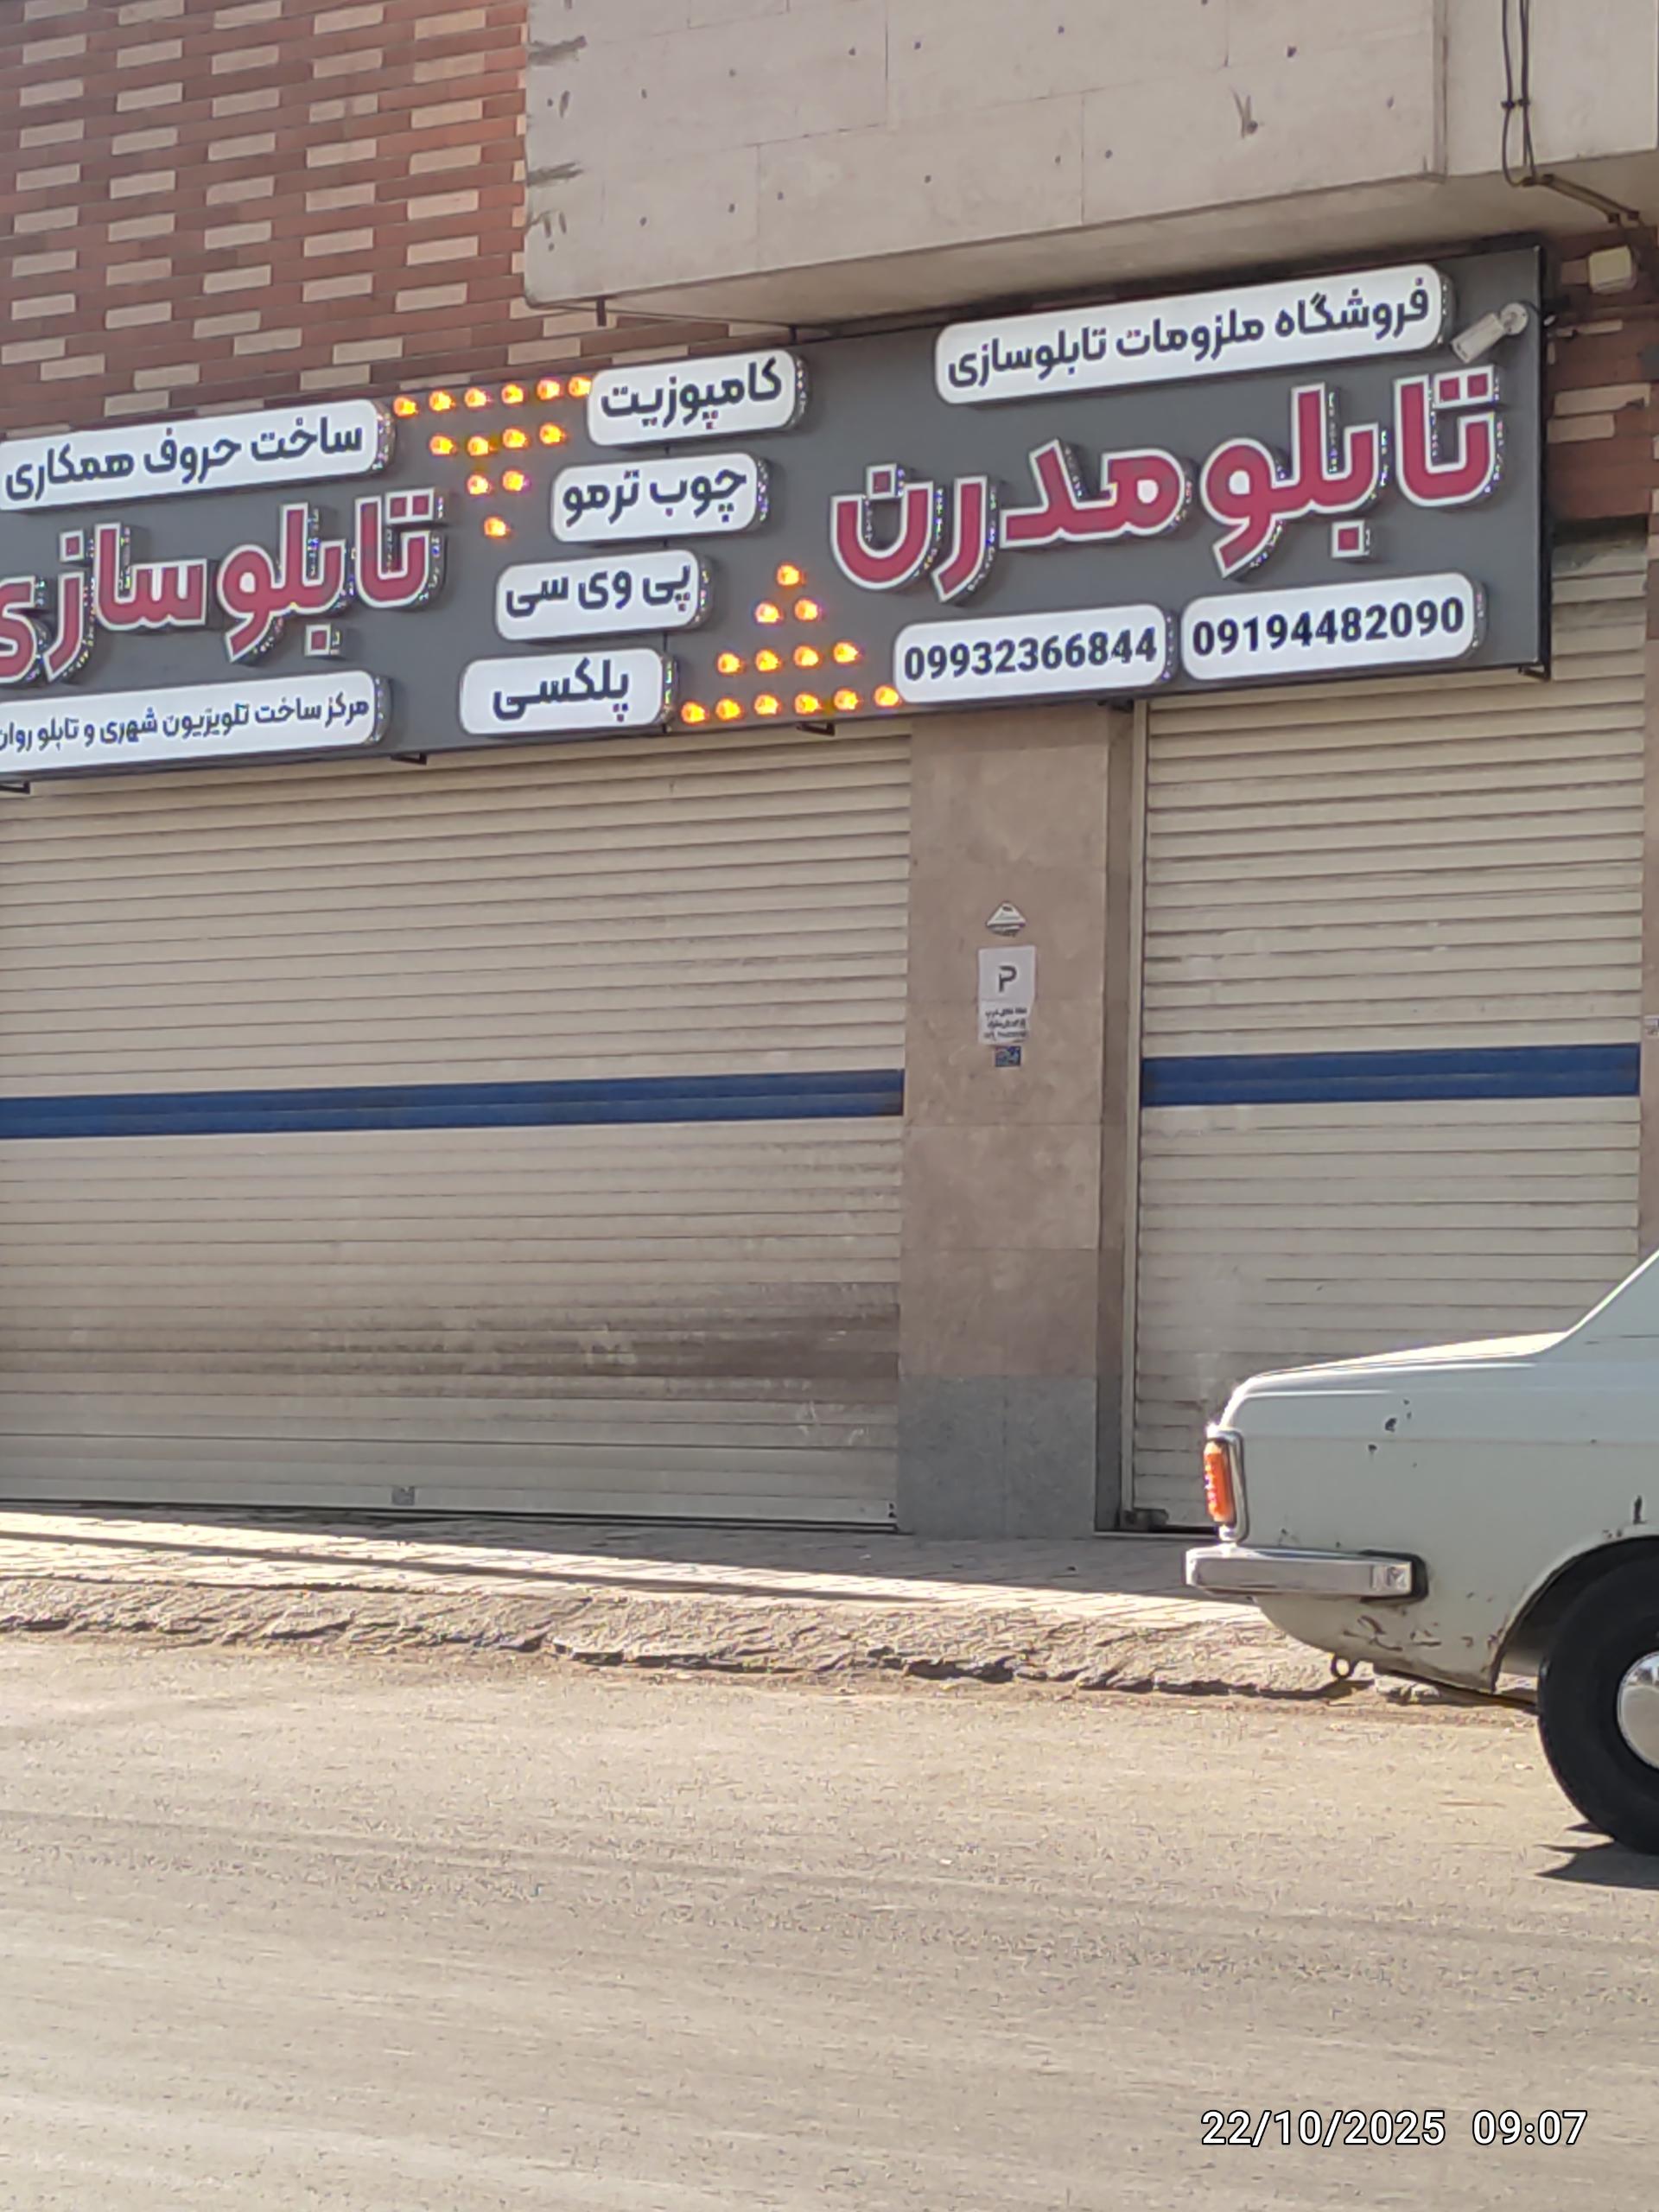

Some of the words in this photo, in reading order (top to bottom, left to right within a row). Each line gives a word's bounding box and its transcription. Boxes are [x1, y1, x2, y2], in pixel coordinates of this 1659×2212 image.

[1275, 277, 1429, 340] فروشگاه
[1116, 308, 1264, 361] ملزومات
[600, 357, 782, 430] کامپوزیت
[143, 427, 242, 485] حروف
[250, 416, 363, 461] ساخت
[5, 443, 135, 501] همکاری
[649, 469, 747, 523] چوب
[563, 470, 640, 528] ترمو
[505, 576, 569, 618] سی
[578, 569, 632, 609] وی
[642, 564, 691, 612] پی
[1192, 597, 1465, 658] 09194482090
[903, 625, 1159, 682] 09932366844
[254, 696, 321, 723] ساخت
[324, 691, 370, 728] مرکز
[493, 658, 630, 722] پلکسی
[37, 717, 79, 752] تابلو
[84, 723, 95, 747] و
[99, 707, 158, 744] شهری
[162, 702, 250, 739] تلویزیون
[998, 965, 1018, 993] P
